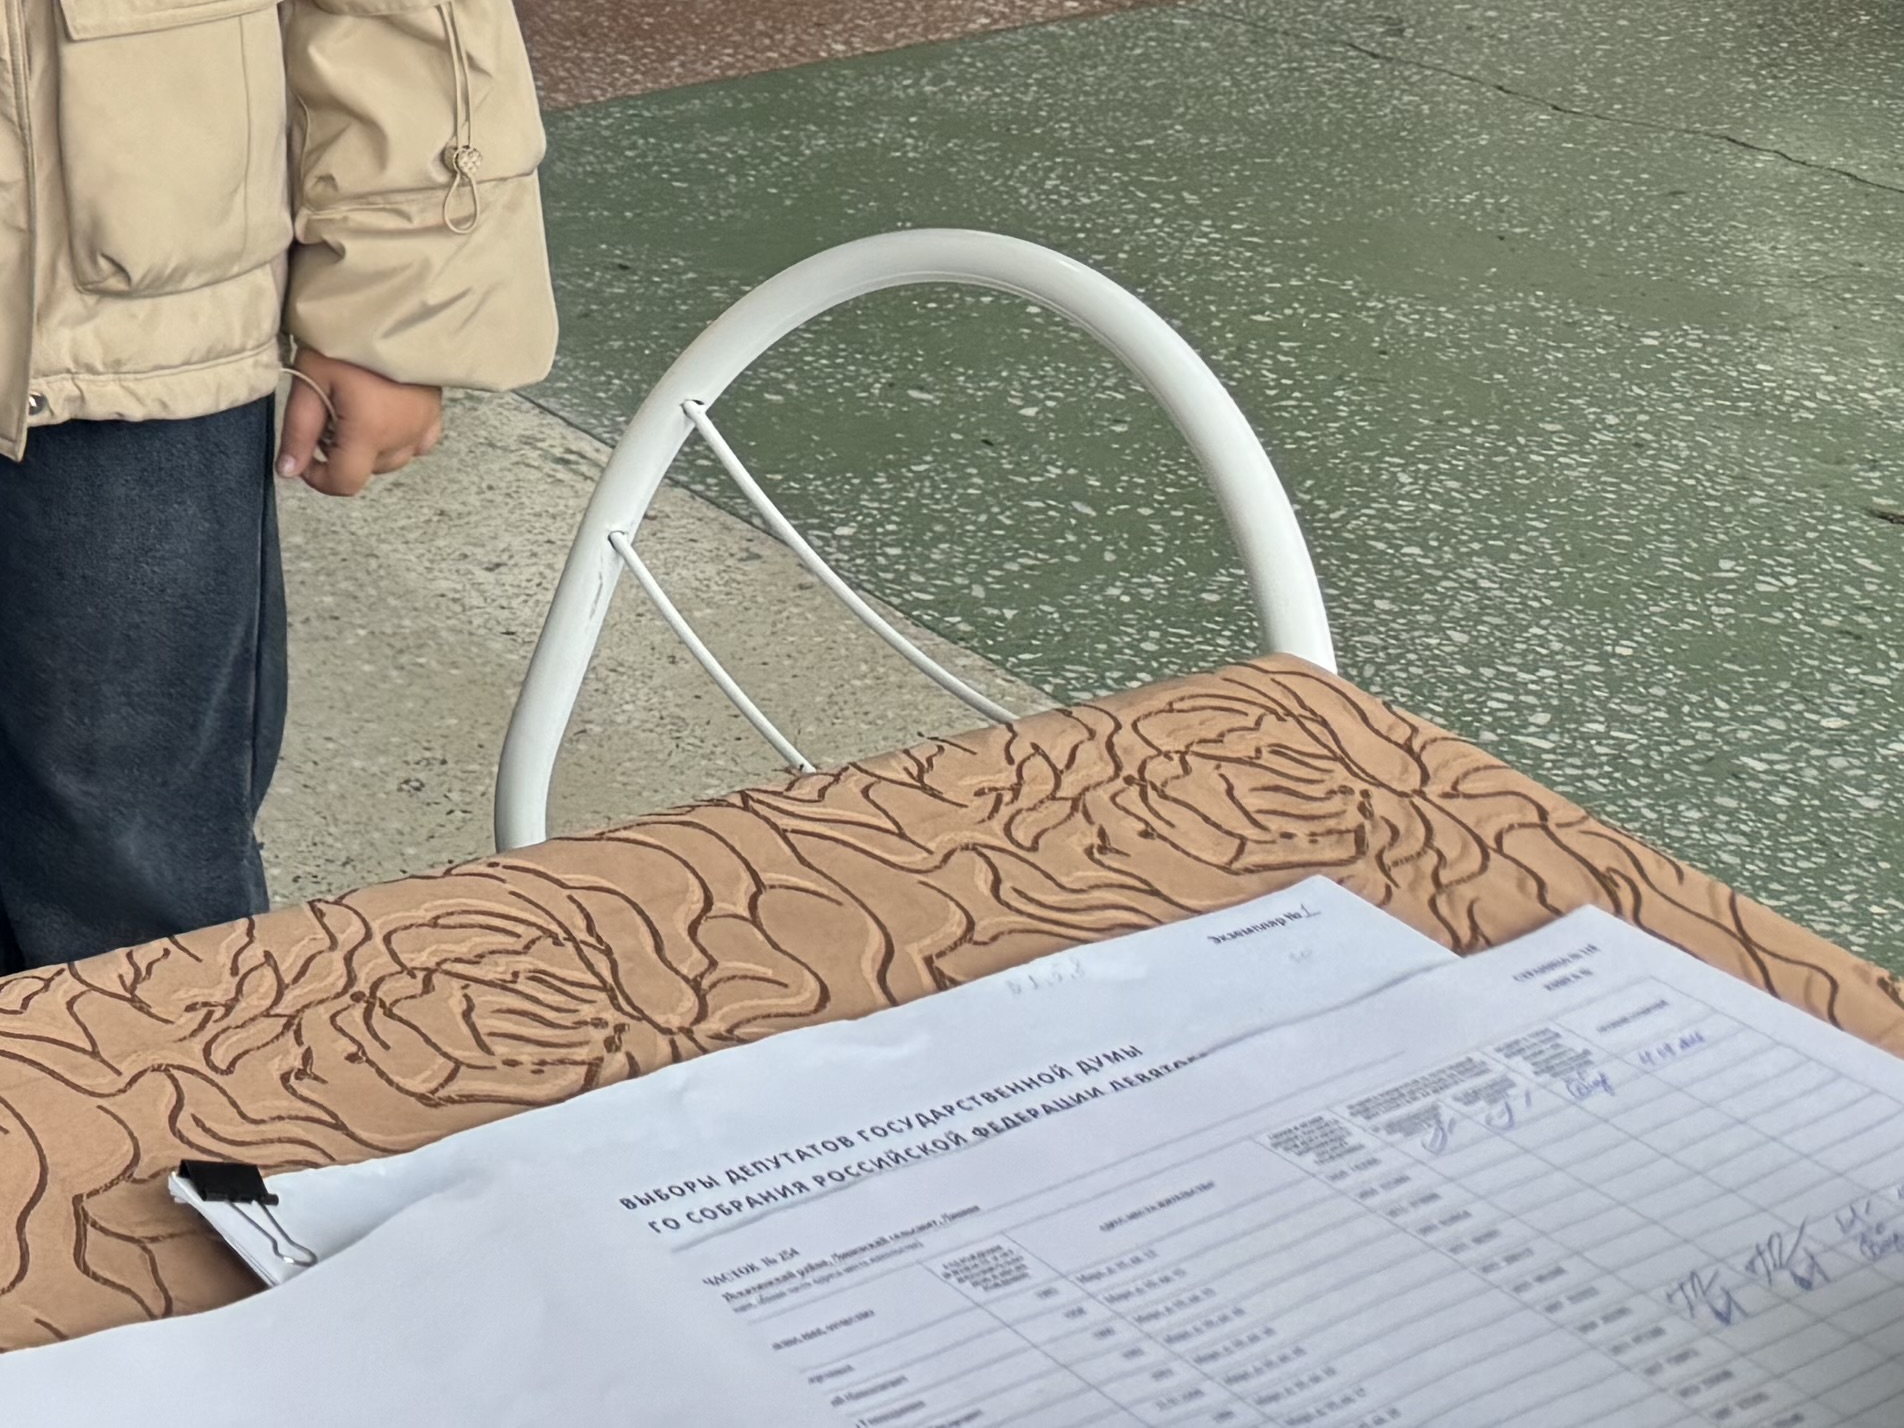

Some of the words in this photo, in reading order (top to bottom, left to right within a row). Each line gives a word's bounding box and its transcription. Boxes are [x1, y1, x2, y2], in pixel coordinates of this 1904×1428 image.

[619, 1174, 721, 1211] ВЫБОРЫ
[724, 1135, 855, 1186] ДЕПУТАТОВ
[856, 1063, 1073, 1143] ГОСУДАРСТВЕННОЙ
[1075, 1044, 1144, 1077] ДУМЫ
[686, 1180, 812, 1225] СОБРАНИЯ
[812, 1130, 969, 1189] РОССИЙСКОЙ
[972, 1085, 1105, 1140] ФЕДЕРАЦИИ
